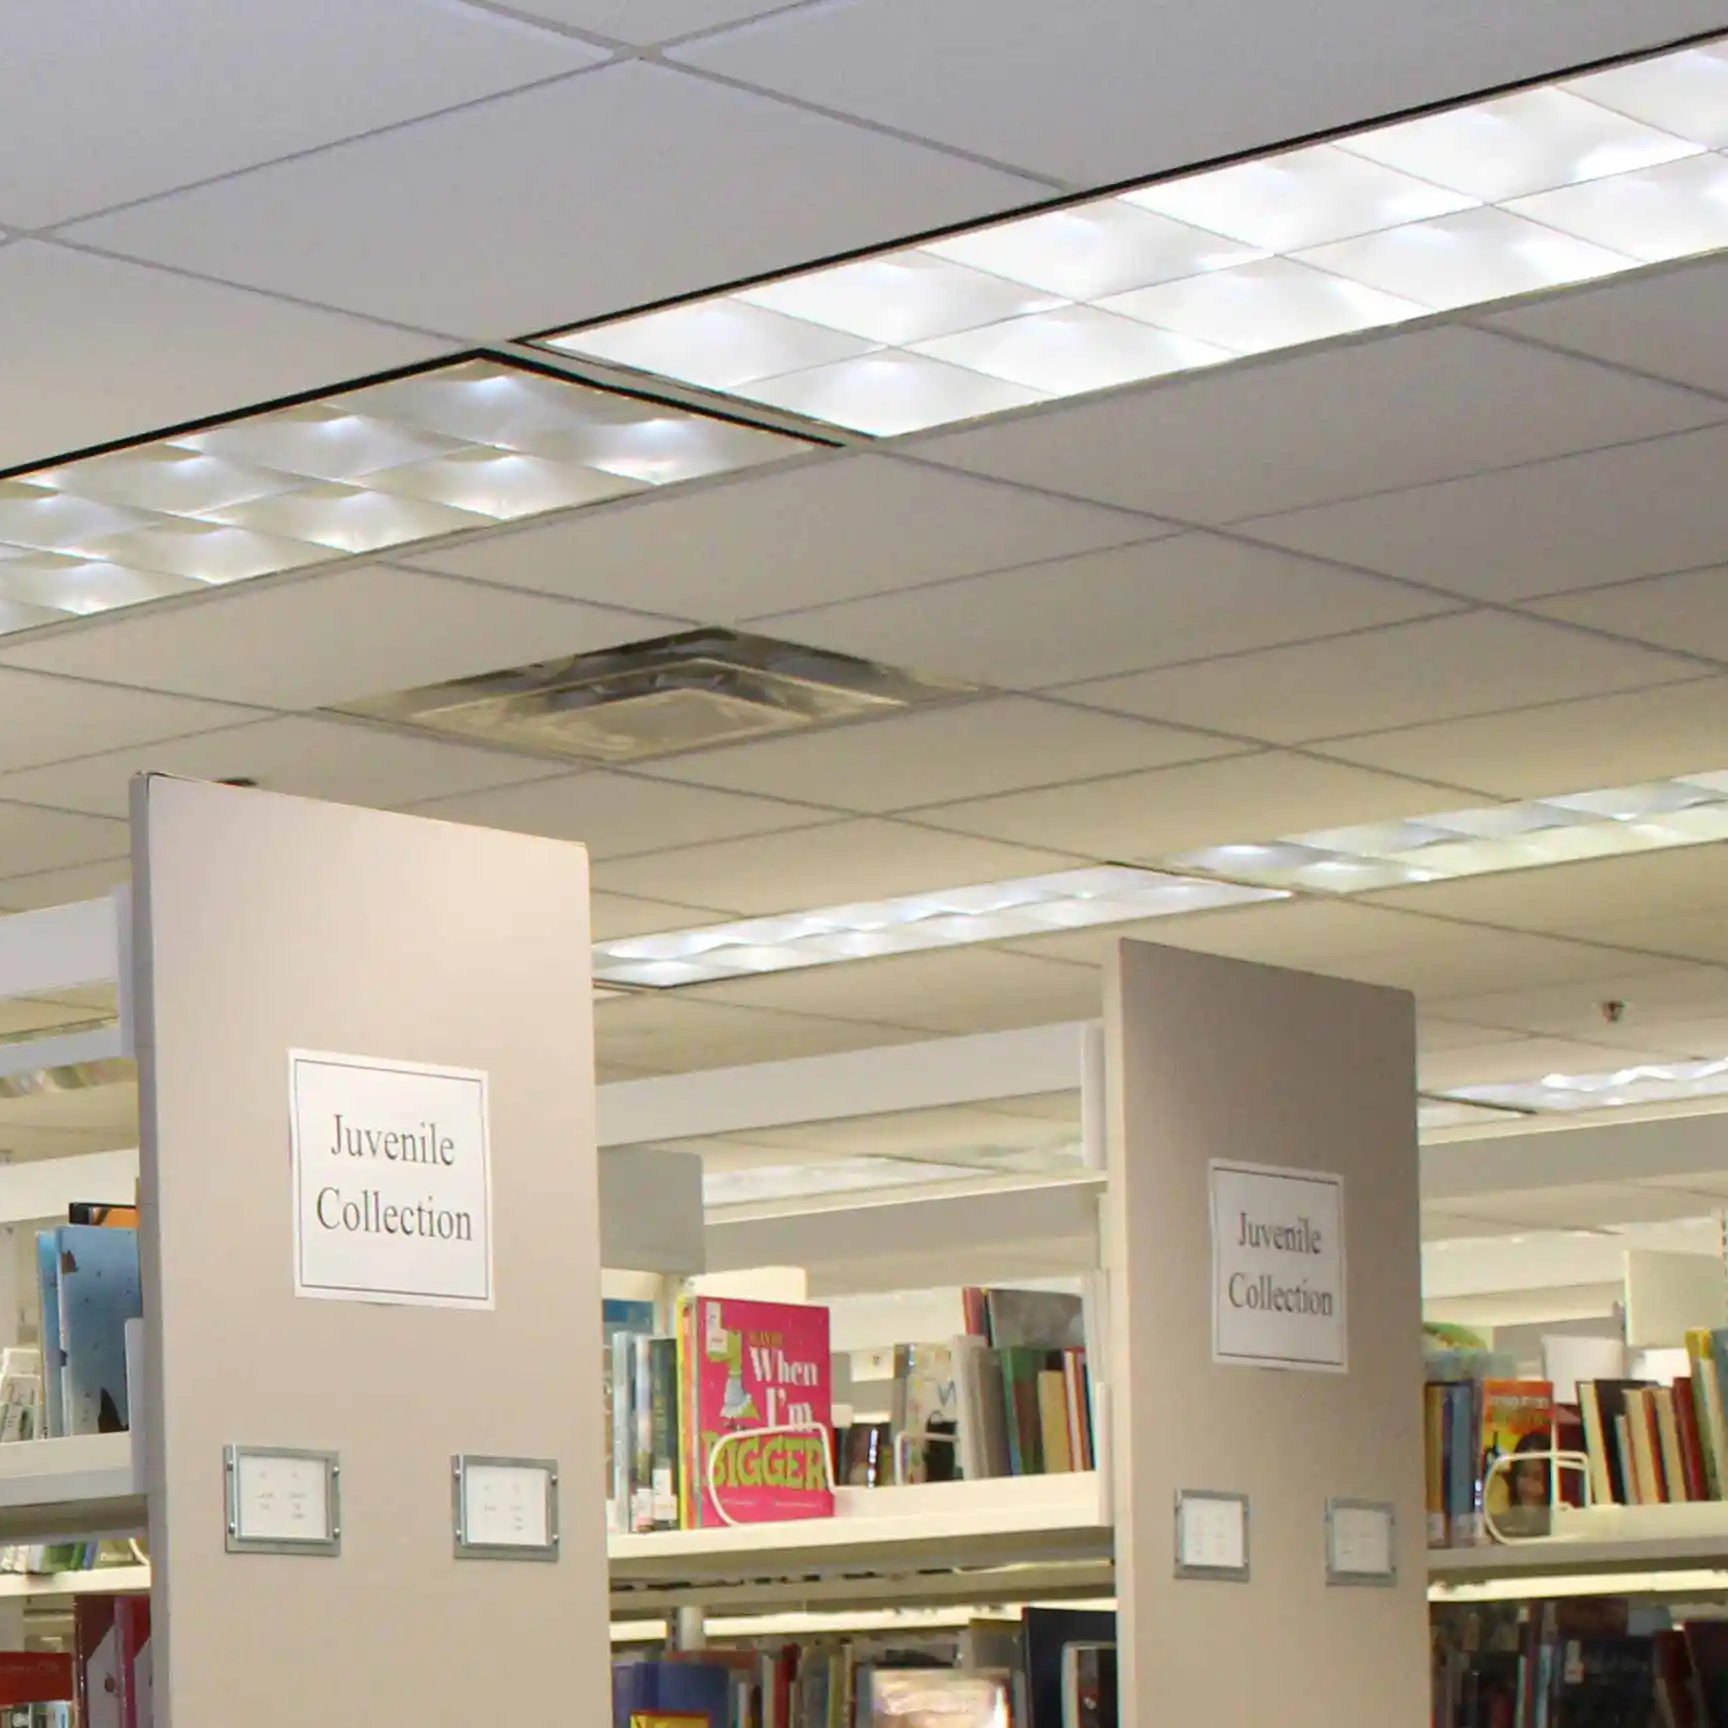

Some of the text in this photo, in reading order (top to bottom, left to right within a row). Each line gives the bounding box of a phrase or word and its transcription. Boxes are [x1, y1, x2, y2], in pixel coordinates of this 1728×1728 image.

[331, 1114, 455, 1165] Juvenile
[316, 1186, 472, 1241] Collection
[1238, 1212, 1322, 1255] Juvenile
[1228, 1272, 1333, 1317] Collection
[750, 1347, 819, 1386] When
[766, 1387, 813, 1432] I'm
[702, 1431, 827, 1490] BIGGER
